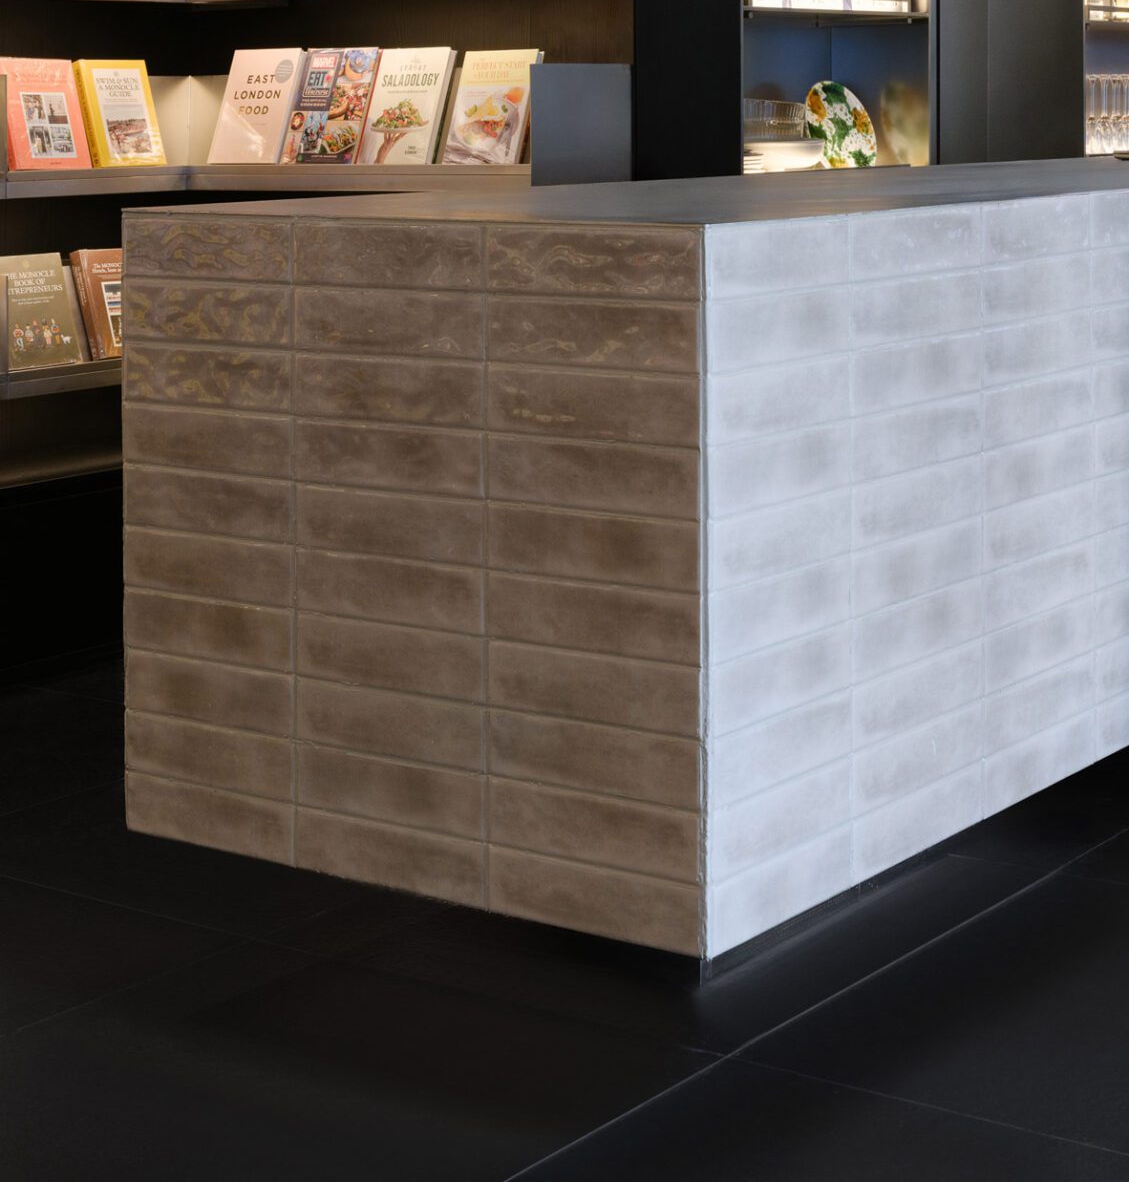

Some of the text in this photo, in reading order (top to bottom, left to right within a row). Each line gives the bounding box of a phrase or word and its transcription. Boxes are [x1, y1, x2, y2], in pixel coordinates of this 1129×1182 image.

[247, 74, 275, 84] EAST
[308, 71, 328, 86] EAT
[381, 73, 440, 88] SALADOLOGY
[234, 89, 281, 100] LONDON
[238, 106, 269, 115] FOOD
[18, 269, 56, 279] MONOCLE
[14, 279, 34, 287] BOOK
